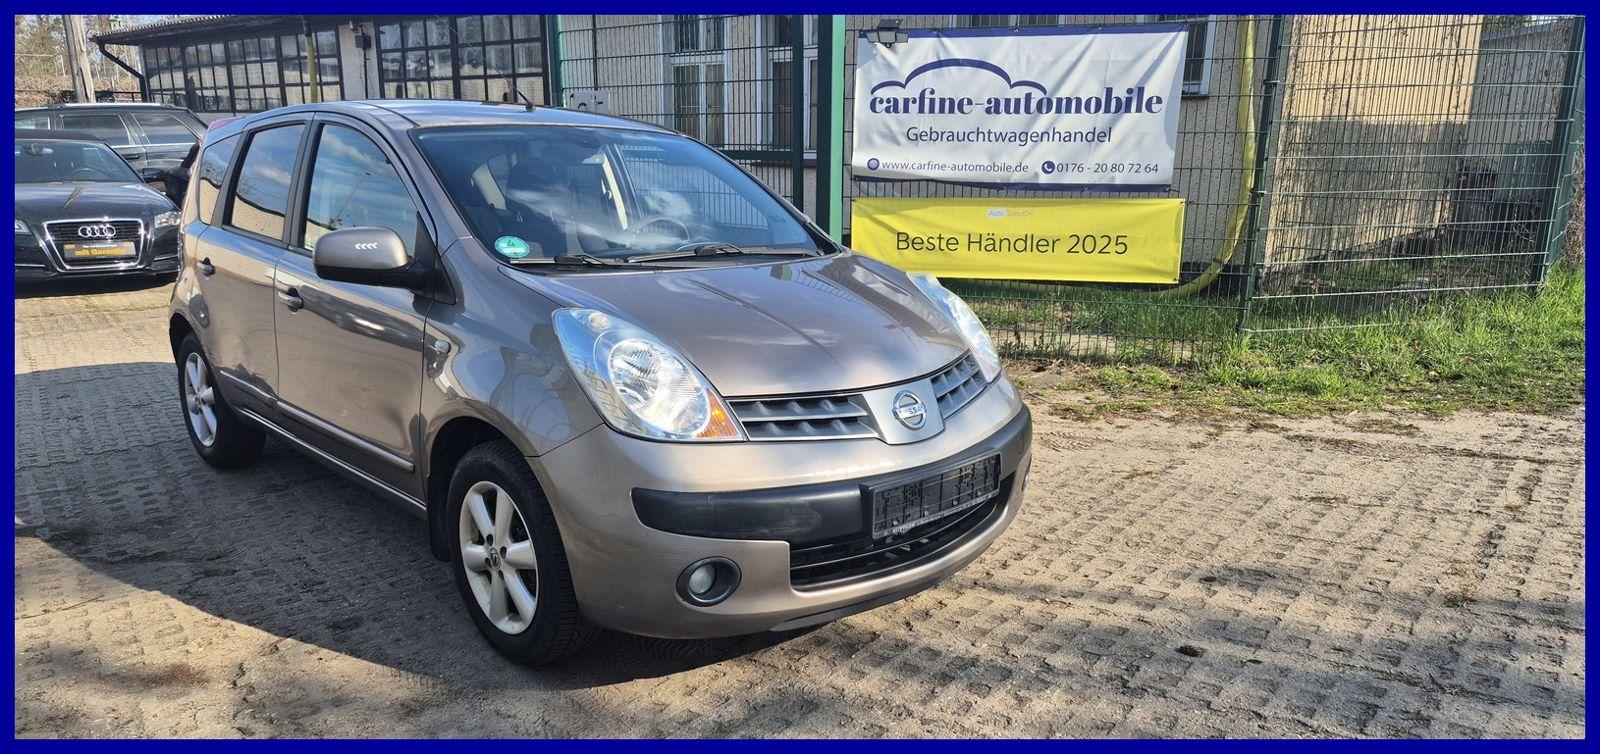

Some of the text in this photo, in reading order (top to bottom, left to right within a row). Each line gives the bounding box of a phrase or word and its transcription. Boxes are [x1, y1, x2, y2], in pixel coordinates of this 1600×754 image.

[869, 86, 1163, 115] carfine-automobile
[906, 126, 1112, 147] Gebrauchtwagenhandel
[882, 161, 1029, 173] www.carfine-automobile.de
[1056, 162, 1085, 173] 0176
[1093, 163, 1108, 174] 20
[1110, 163, 1125, 174] 80
[1127, 163, 1142, 174] 72
[1144, 163, 1159, 174] 64
[896, 231, 1129, 255] Beste Händler 2025
